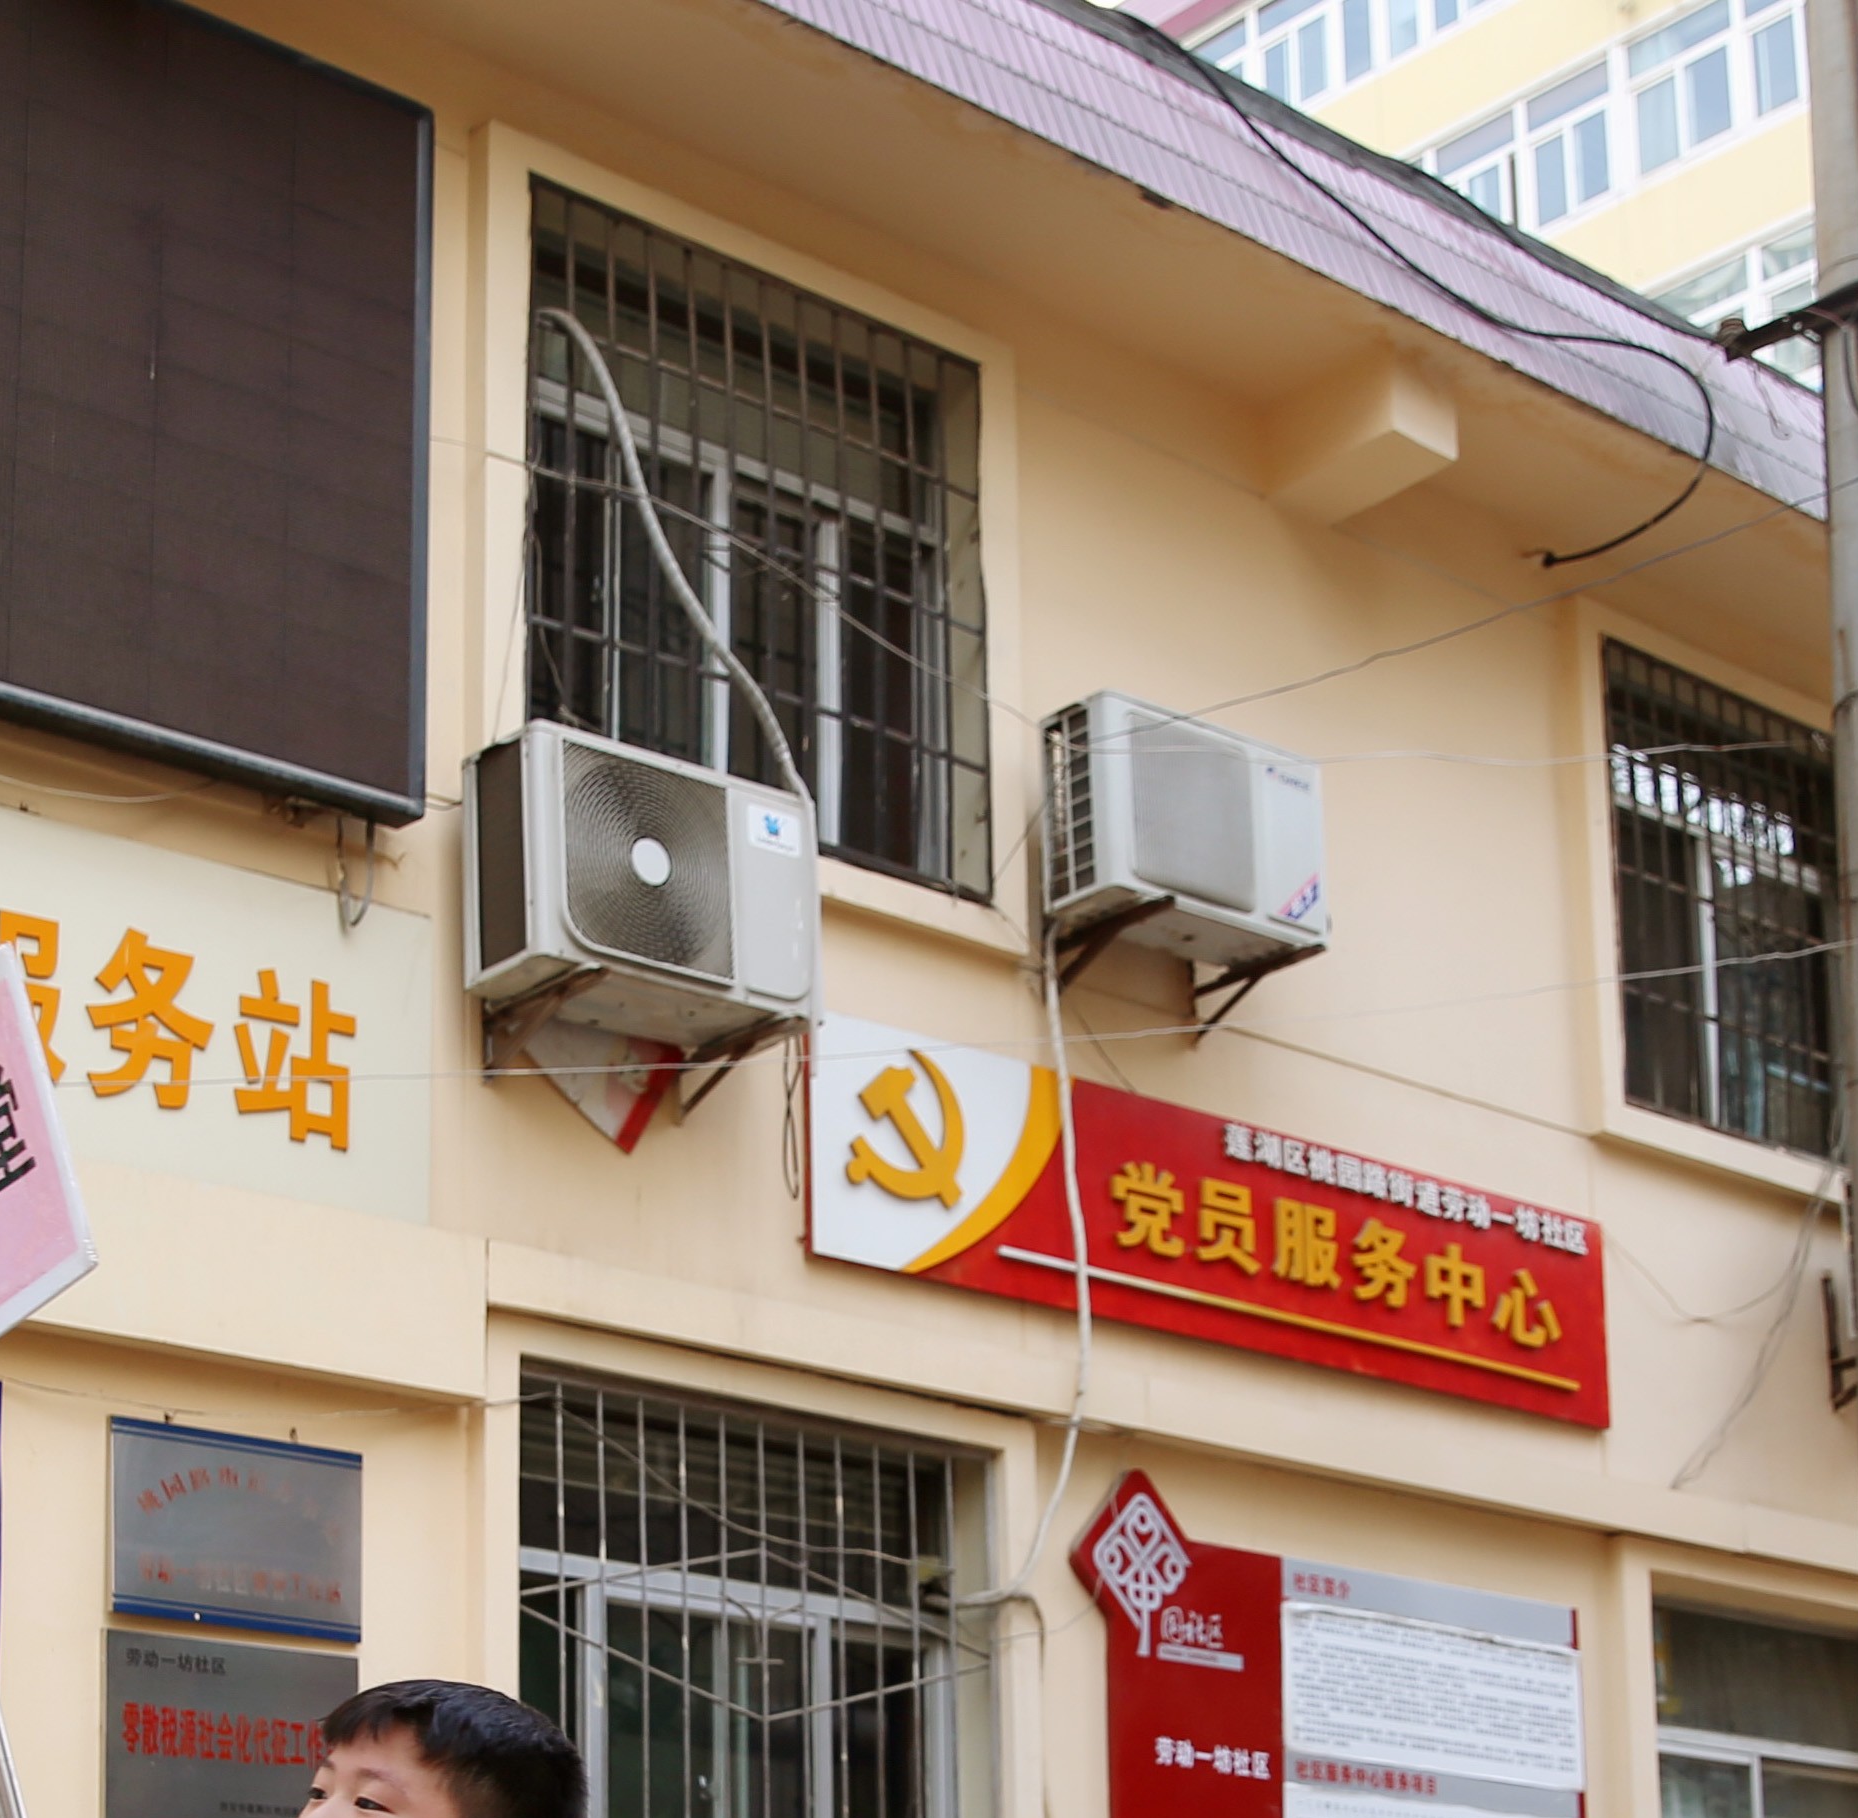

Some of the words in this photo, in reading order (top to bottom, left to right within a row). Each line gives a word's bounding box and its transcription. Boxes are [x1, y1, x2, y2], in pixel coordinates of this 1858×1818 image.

[1111, 1160, 1563, 1350] 党员服务中心
[126, 1648, 227, 1676] 劳动一坊社区
[121, 1702, 332, 1770] 零散税源社会化代征工作
[1154, 1736, 1272, 1781] 劳动一坊社区
